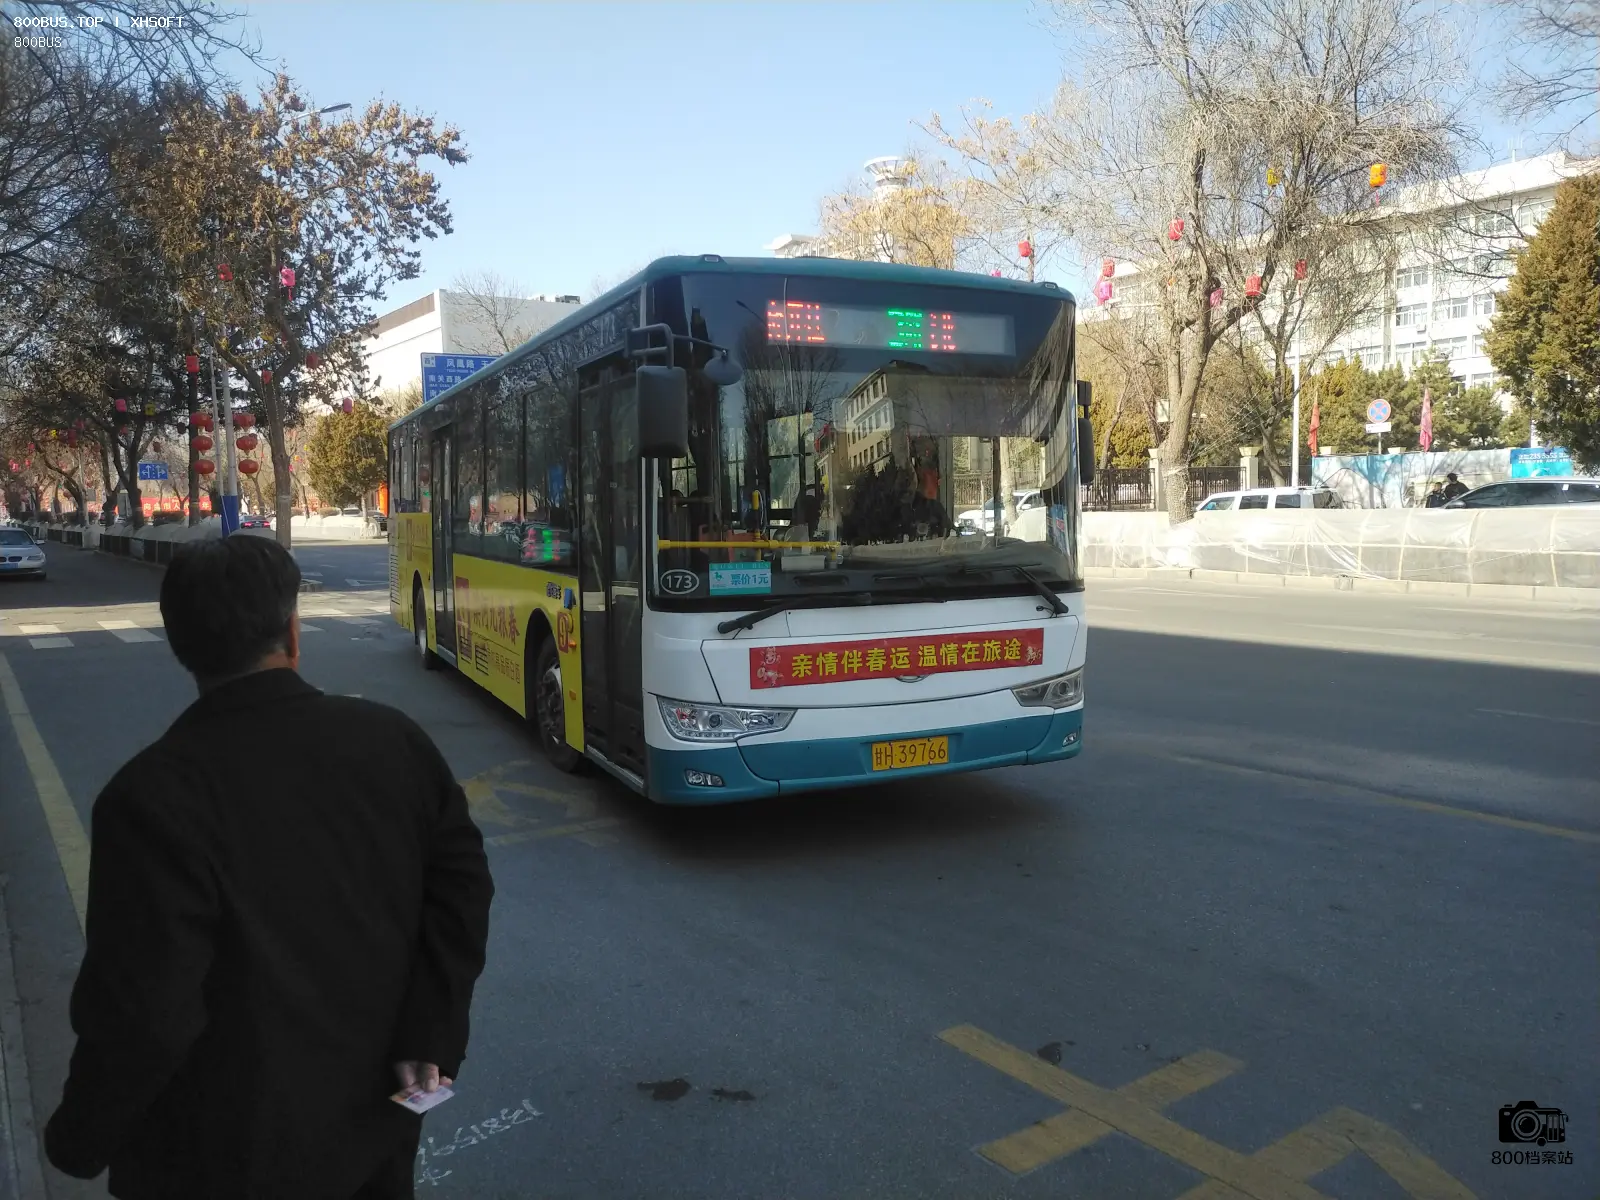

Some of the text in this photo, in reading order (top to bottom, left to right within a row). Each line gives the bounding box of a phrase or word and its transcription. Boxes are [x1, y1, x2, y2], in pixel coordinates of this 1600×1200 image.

[446, 358, 475, 369] 凤凰路
[666, 575, 693, 589] 173
[730, 573, 769, 586] 票价1元
[791, 638, 1023, 678] 亲情伴春运 温情在旅途
